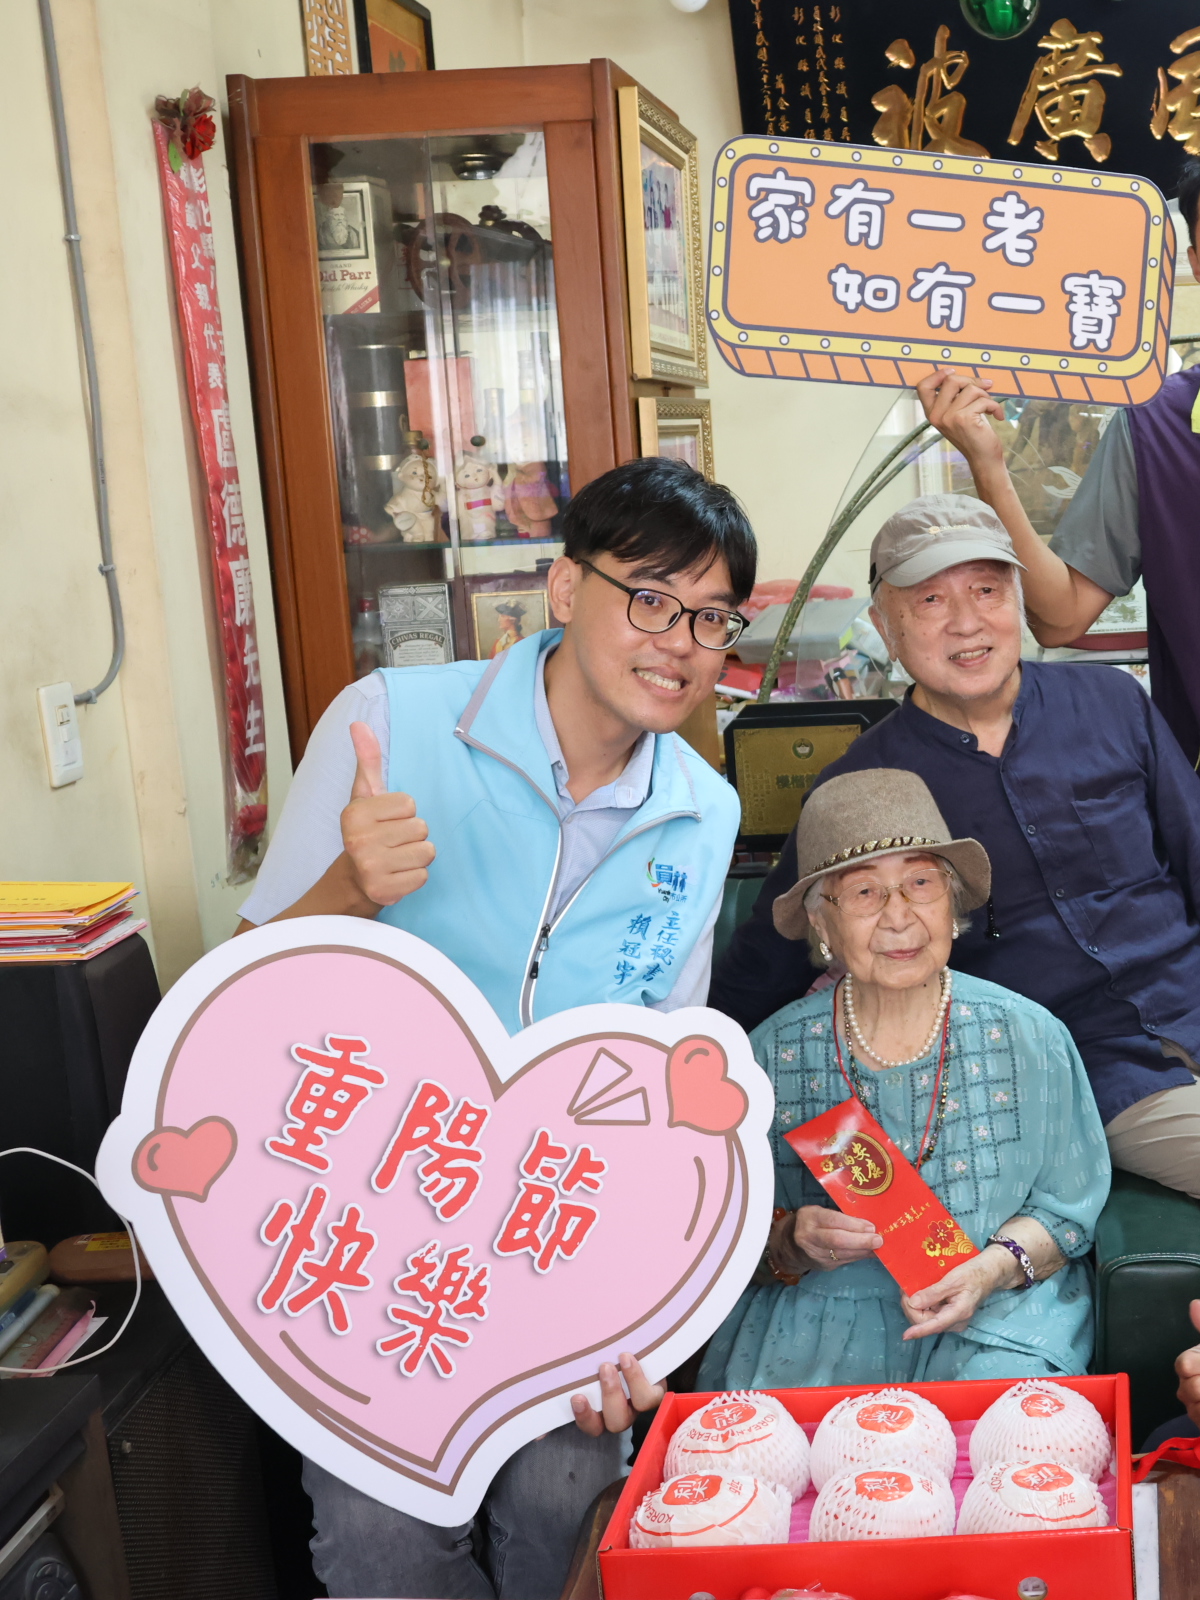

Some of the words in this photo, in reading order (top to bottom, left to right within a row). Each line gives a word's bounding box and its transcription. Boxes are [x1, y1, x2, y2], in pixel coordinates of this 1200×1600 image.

[746, 167, 1044, 267] 家有一老
[341, 270, 372, 282] Parr
[828, 261, 1125, 352] 如有一寶
[391, 632, 418, 645] CHIVAS
[420, 632, 443, 643] REGAL
[265, 1034, 607, 1273] 重陽節
[258, 1185, 490, 1377] 快樂
